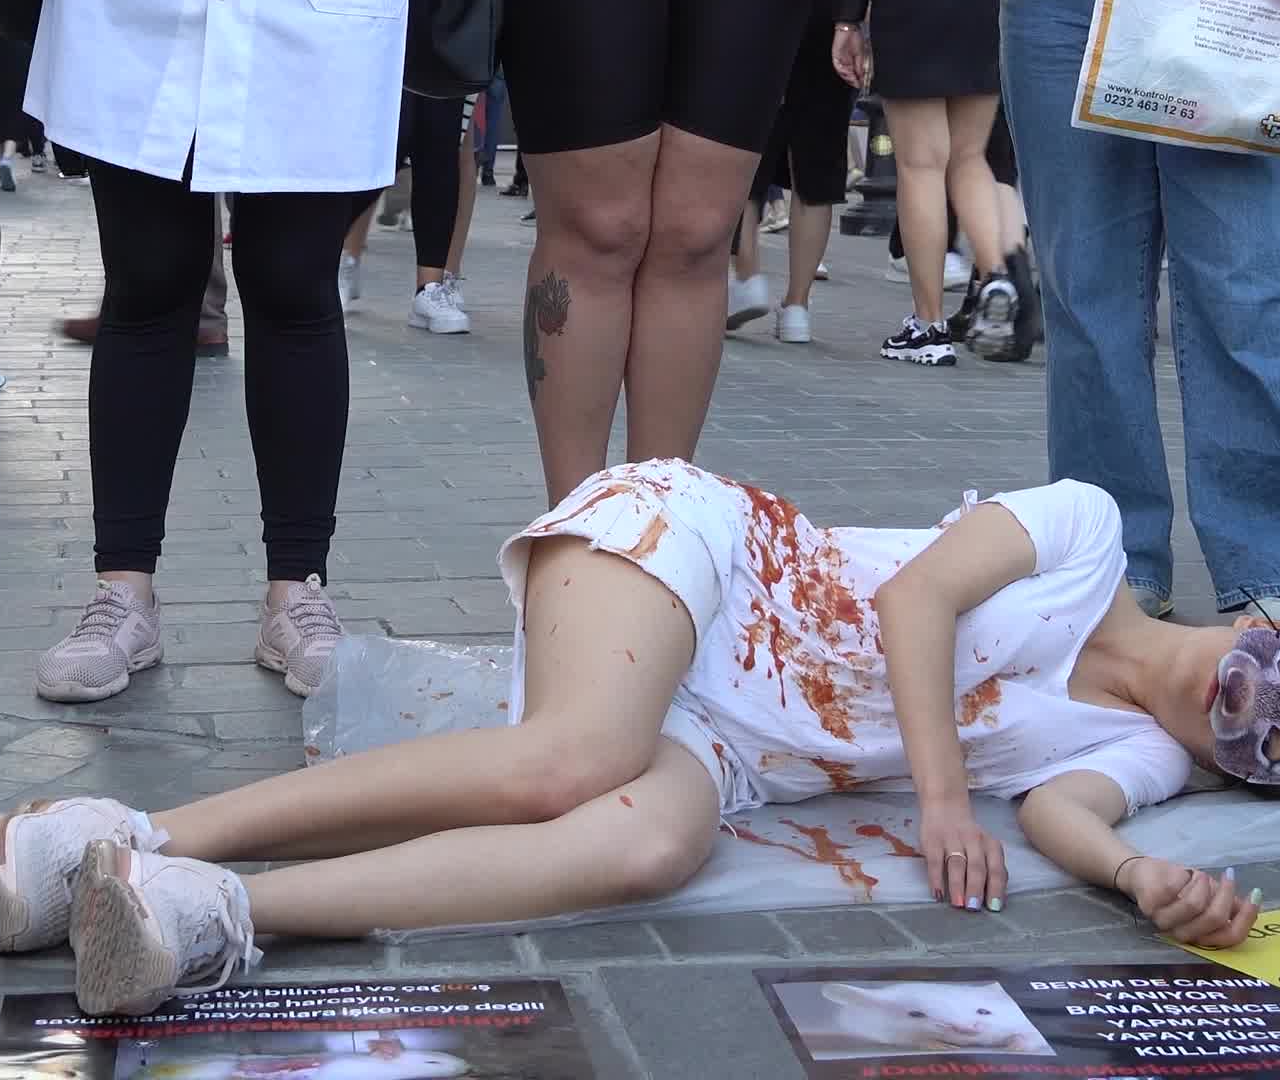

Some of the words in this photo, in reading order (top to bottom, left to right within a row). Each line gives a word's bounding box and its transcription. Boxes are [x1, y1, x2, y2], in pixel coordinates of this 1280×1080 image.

[1104, 93, 1133, 109] 0232
[1136, 98, 1159, 113] 463
[1162, 103, 1178, 116] 12
[1179, 108, 1195, 120] 63
[1029, 978, 1125, 990] BENİM
[1131, 978, 1170, 987] DE
[1179, 978, 1270, 988] CANIM
[264, 985, 362, 997] bilimsel
[366, 985, 397, 993] ve
[1095, 990, 1229, 1001] YANIYOR
[286, 995, 401, 1008] harcayın,
[195, 1007, 336, 1020] hayvanlara
[1065, 1003, 1152, 1016] BANA
[1106, 1017, 1267, 1029] YAPMAYIN
[1096, 1030, 1197, 1041] YAPAY
